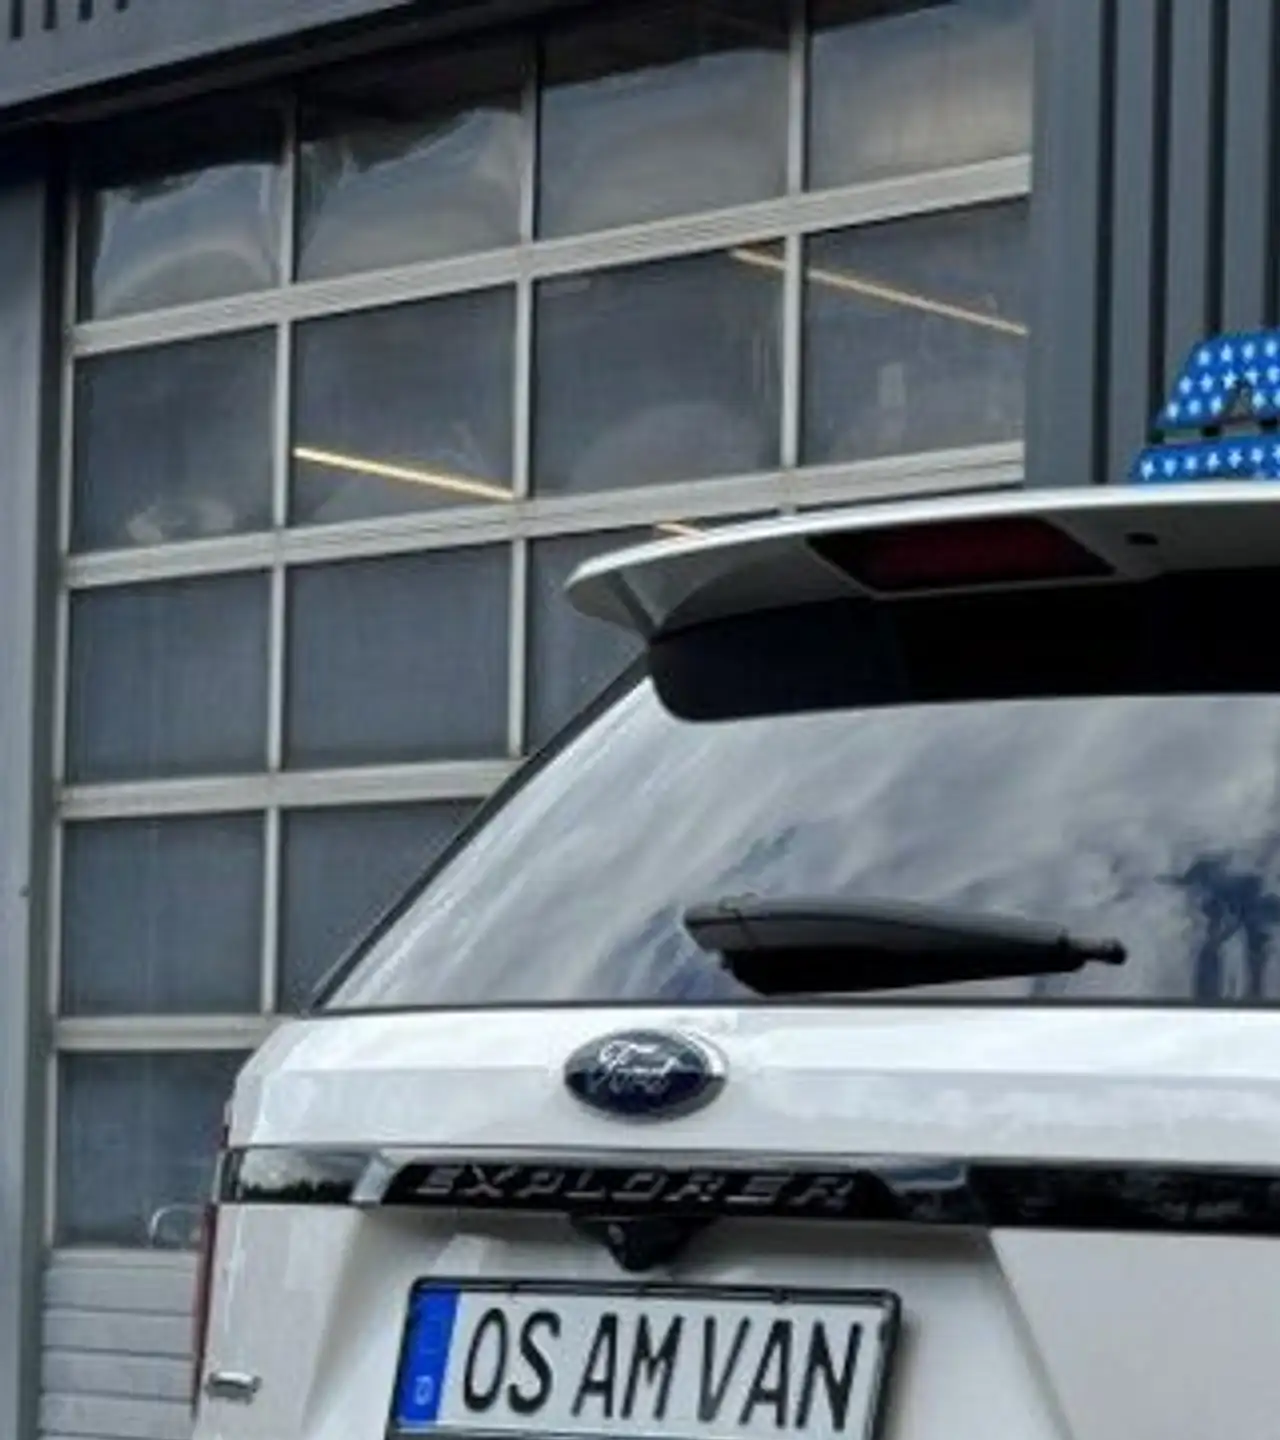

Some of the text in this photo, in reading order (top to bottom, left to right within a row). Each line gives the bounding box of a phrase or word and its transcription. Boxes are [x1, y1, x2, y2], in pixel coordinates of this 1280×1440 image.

[415, 1164, 855, 1210] EXPLORER
[463, 1307, 864, 1431] OS AM VAN
